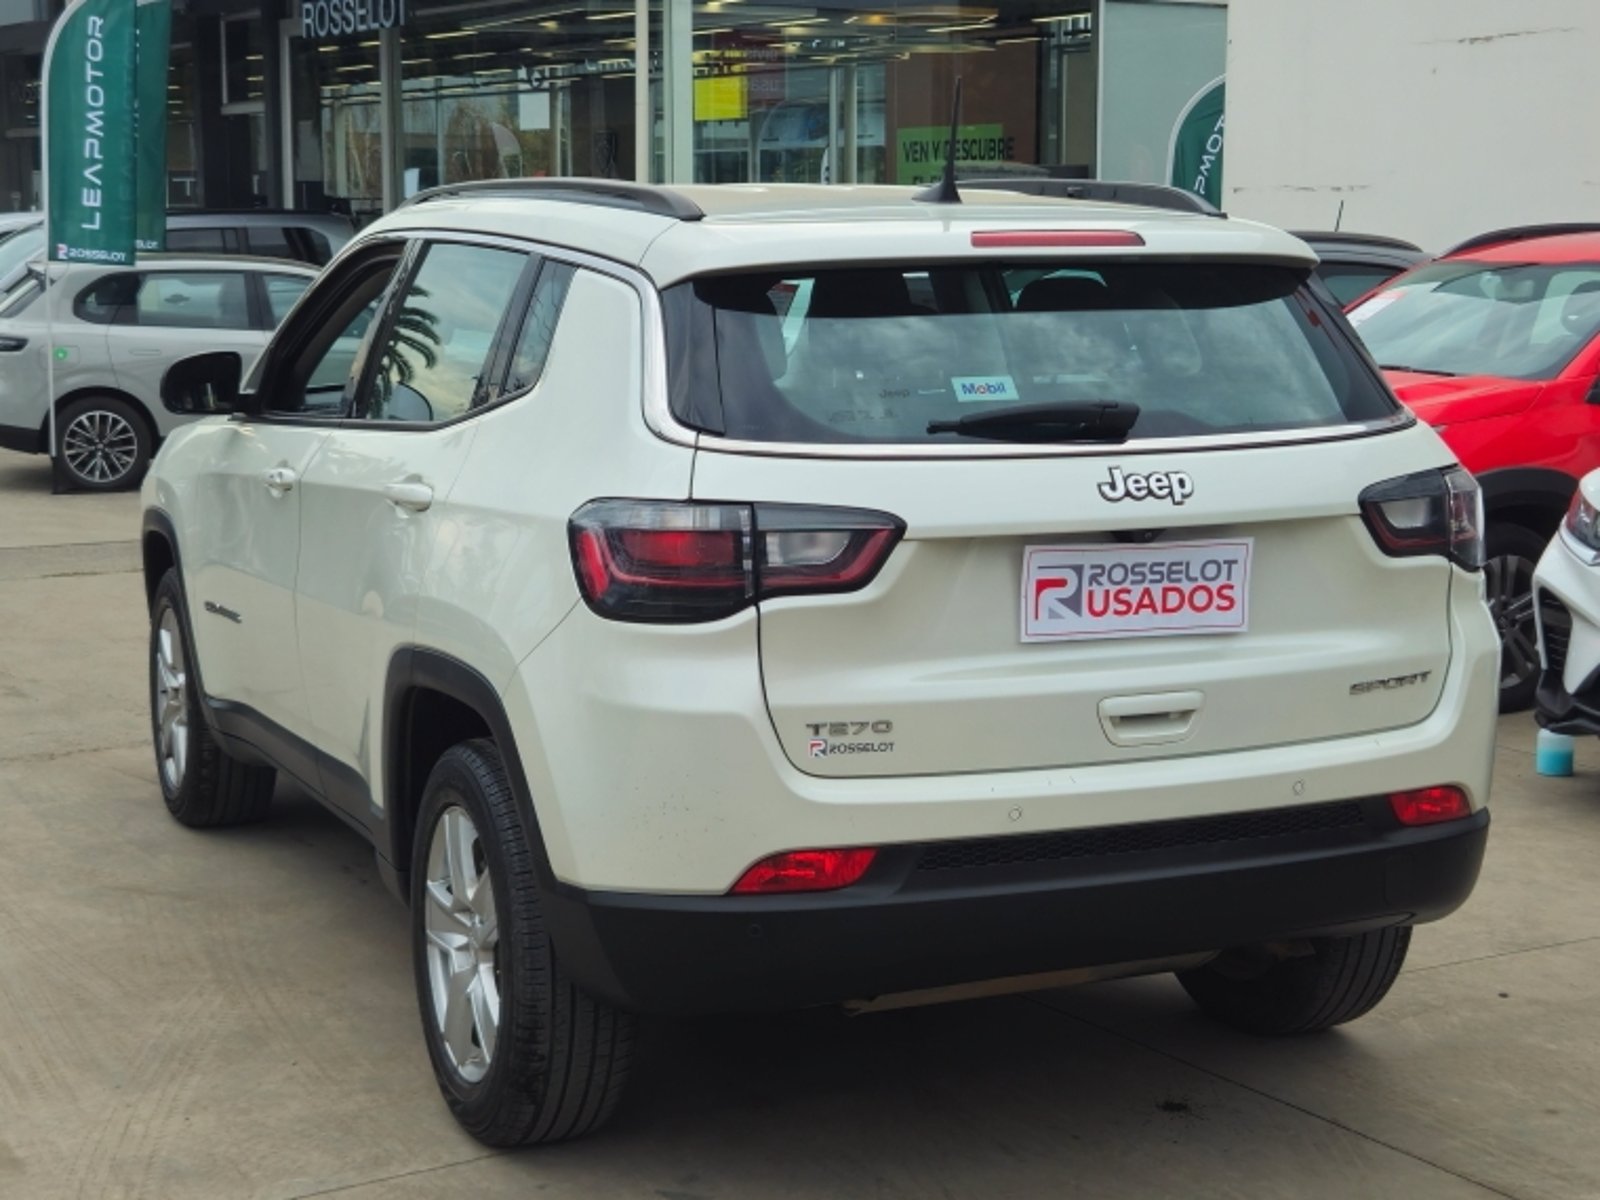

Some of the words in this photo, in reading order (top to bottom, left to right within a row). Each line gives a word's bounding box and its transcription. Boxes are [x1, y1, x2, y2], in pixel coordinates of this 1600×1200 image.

[81, 16, 104, 230] LEAPMOTOR
[903, 141, 928, 162] VEN
[932, 141, 940, 161] Y
[961, 382, 1007, 395] Mobil
[1097, 465, 1194, 505] Jeep
[1088, 559, 1238, 587] ROSSELOT
[1087, 583, 1235, 617] USADOS
[1349, 669, 1432, 695] SPORT
[805, 720, 893, 736] T270
[829, 742, 895, 754] ROSSELOT
